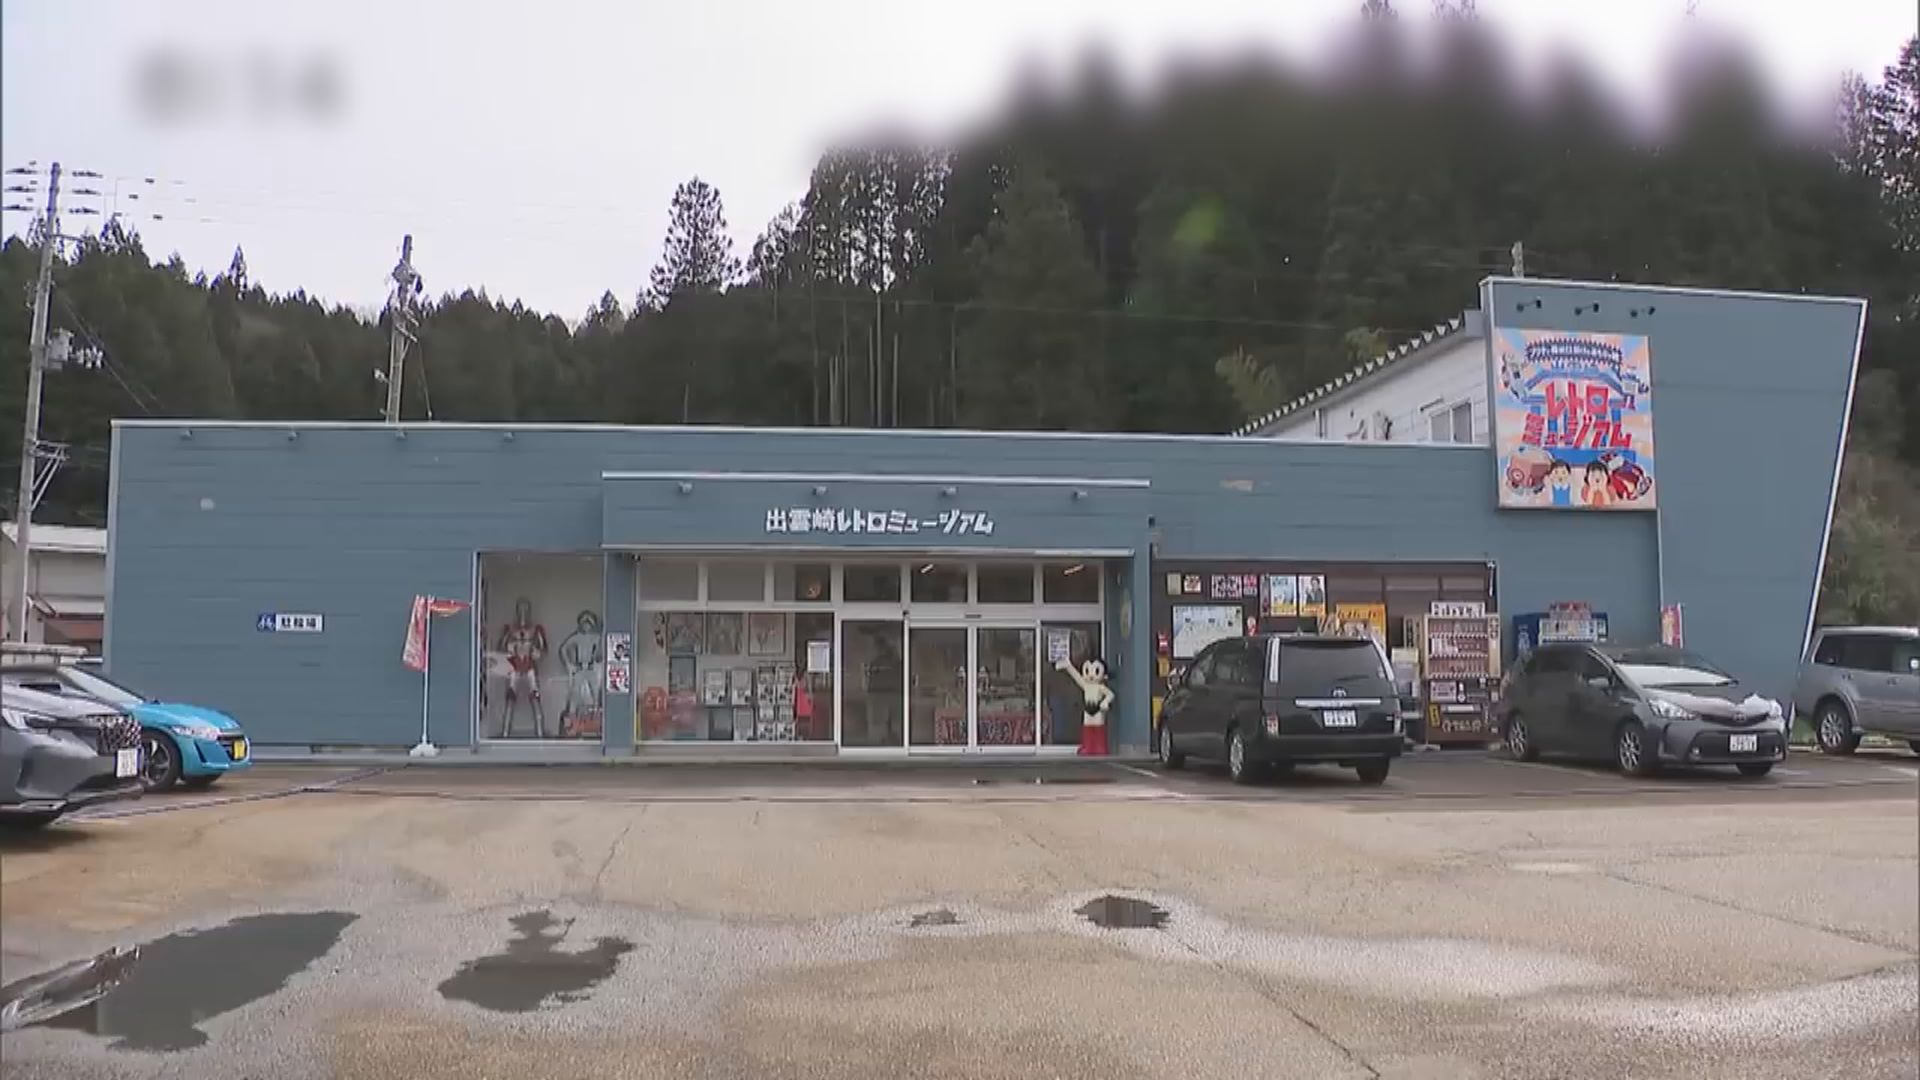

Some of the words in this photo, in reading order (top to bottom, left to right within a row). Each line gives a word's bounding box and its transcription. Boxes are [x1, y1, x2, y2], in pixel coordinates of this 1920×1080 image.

[765, 508, 995, 535] 出雲崎レトロミュージアム
